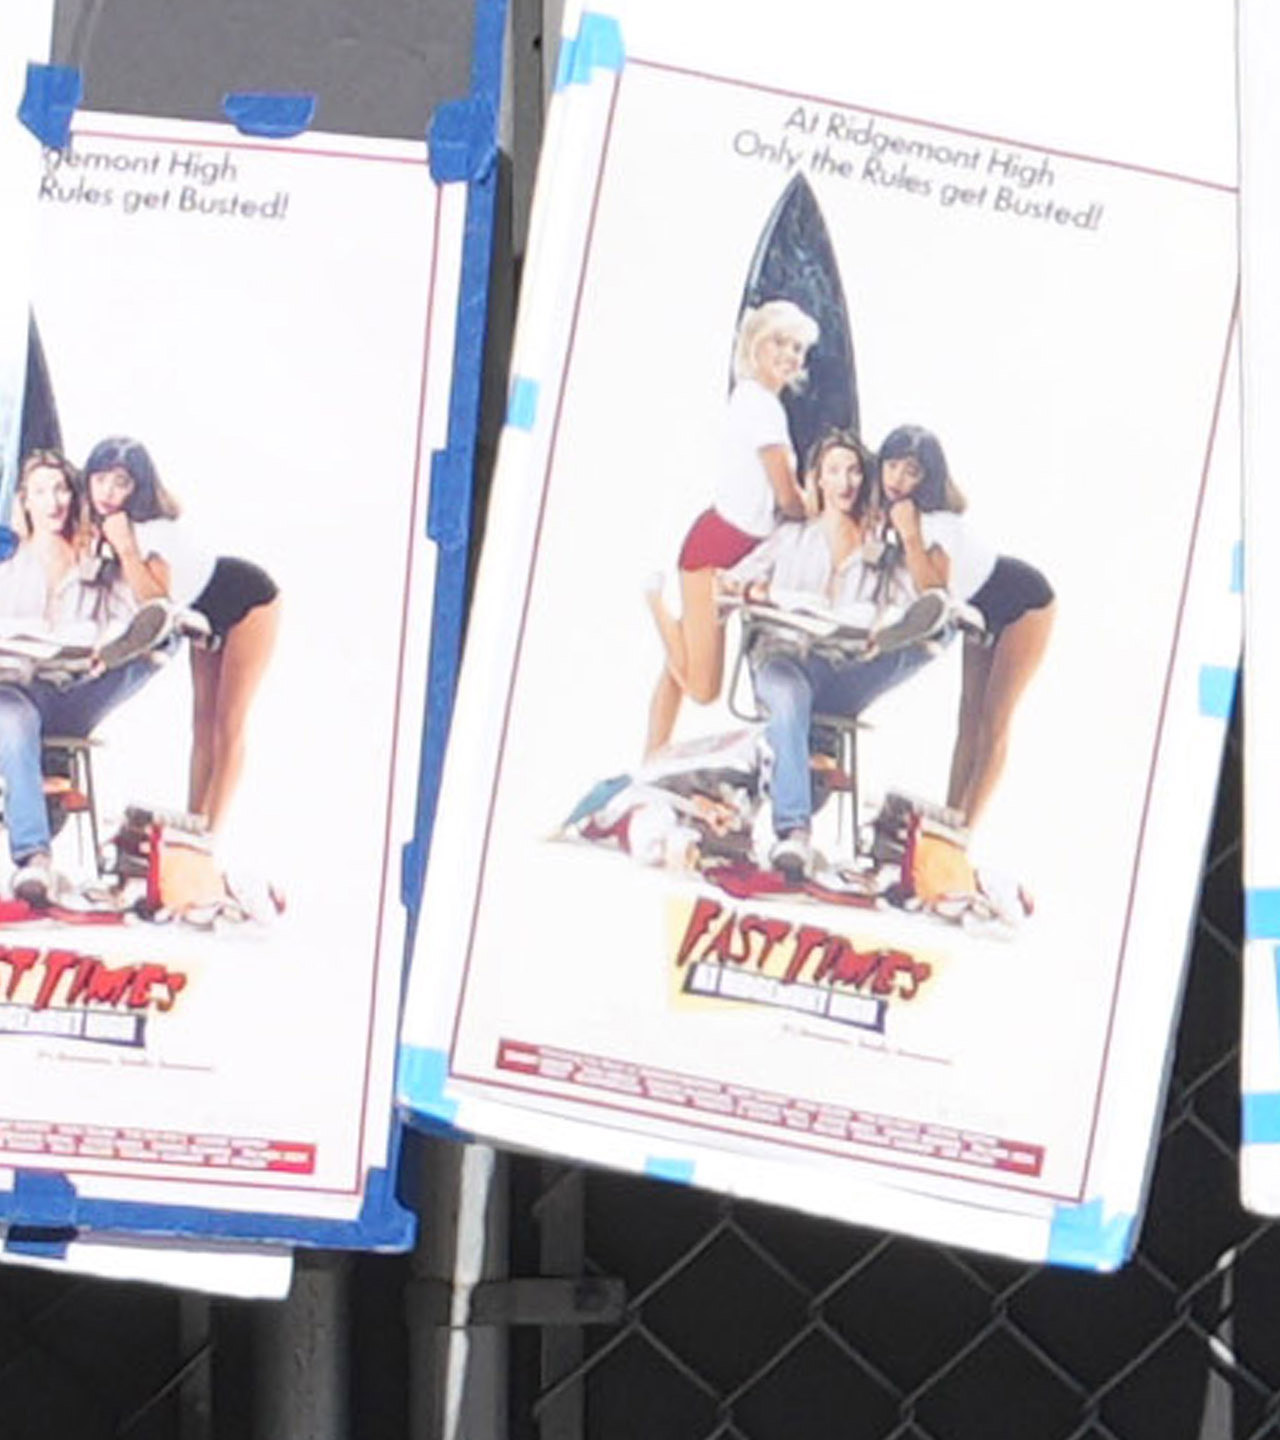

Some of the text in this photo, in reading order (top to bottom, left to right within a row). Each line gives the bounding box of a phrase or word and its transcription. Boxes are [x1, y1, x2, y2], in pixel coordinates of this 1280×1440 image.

[168, 151, 237, 186] High
[733, 129, 1105, 231] Only the Rules get Busted!
[785, 106, 1056, 188] At Ridgemont High
[38, 176, 289, 220] Rules get Busted!
[32, 948, 188, 1012] TIMES
[676, 897, 792, 968] FAST
[781, 923, 932, 1000] TIMES
